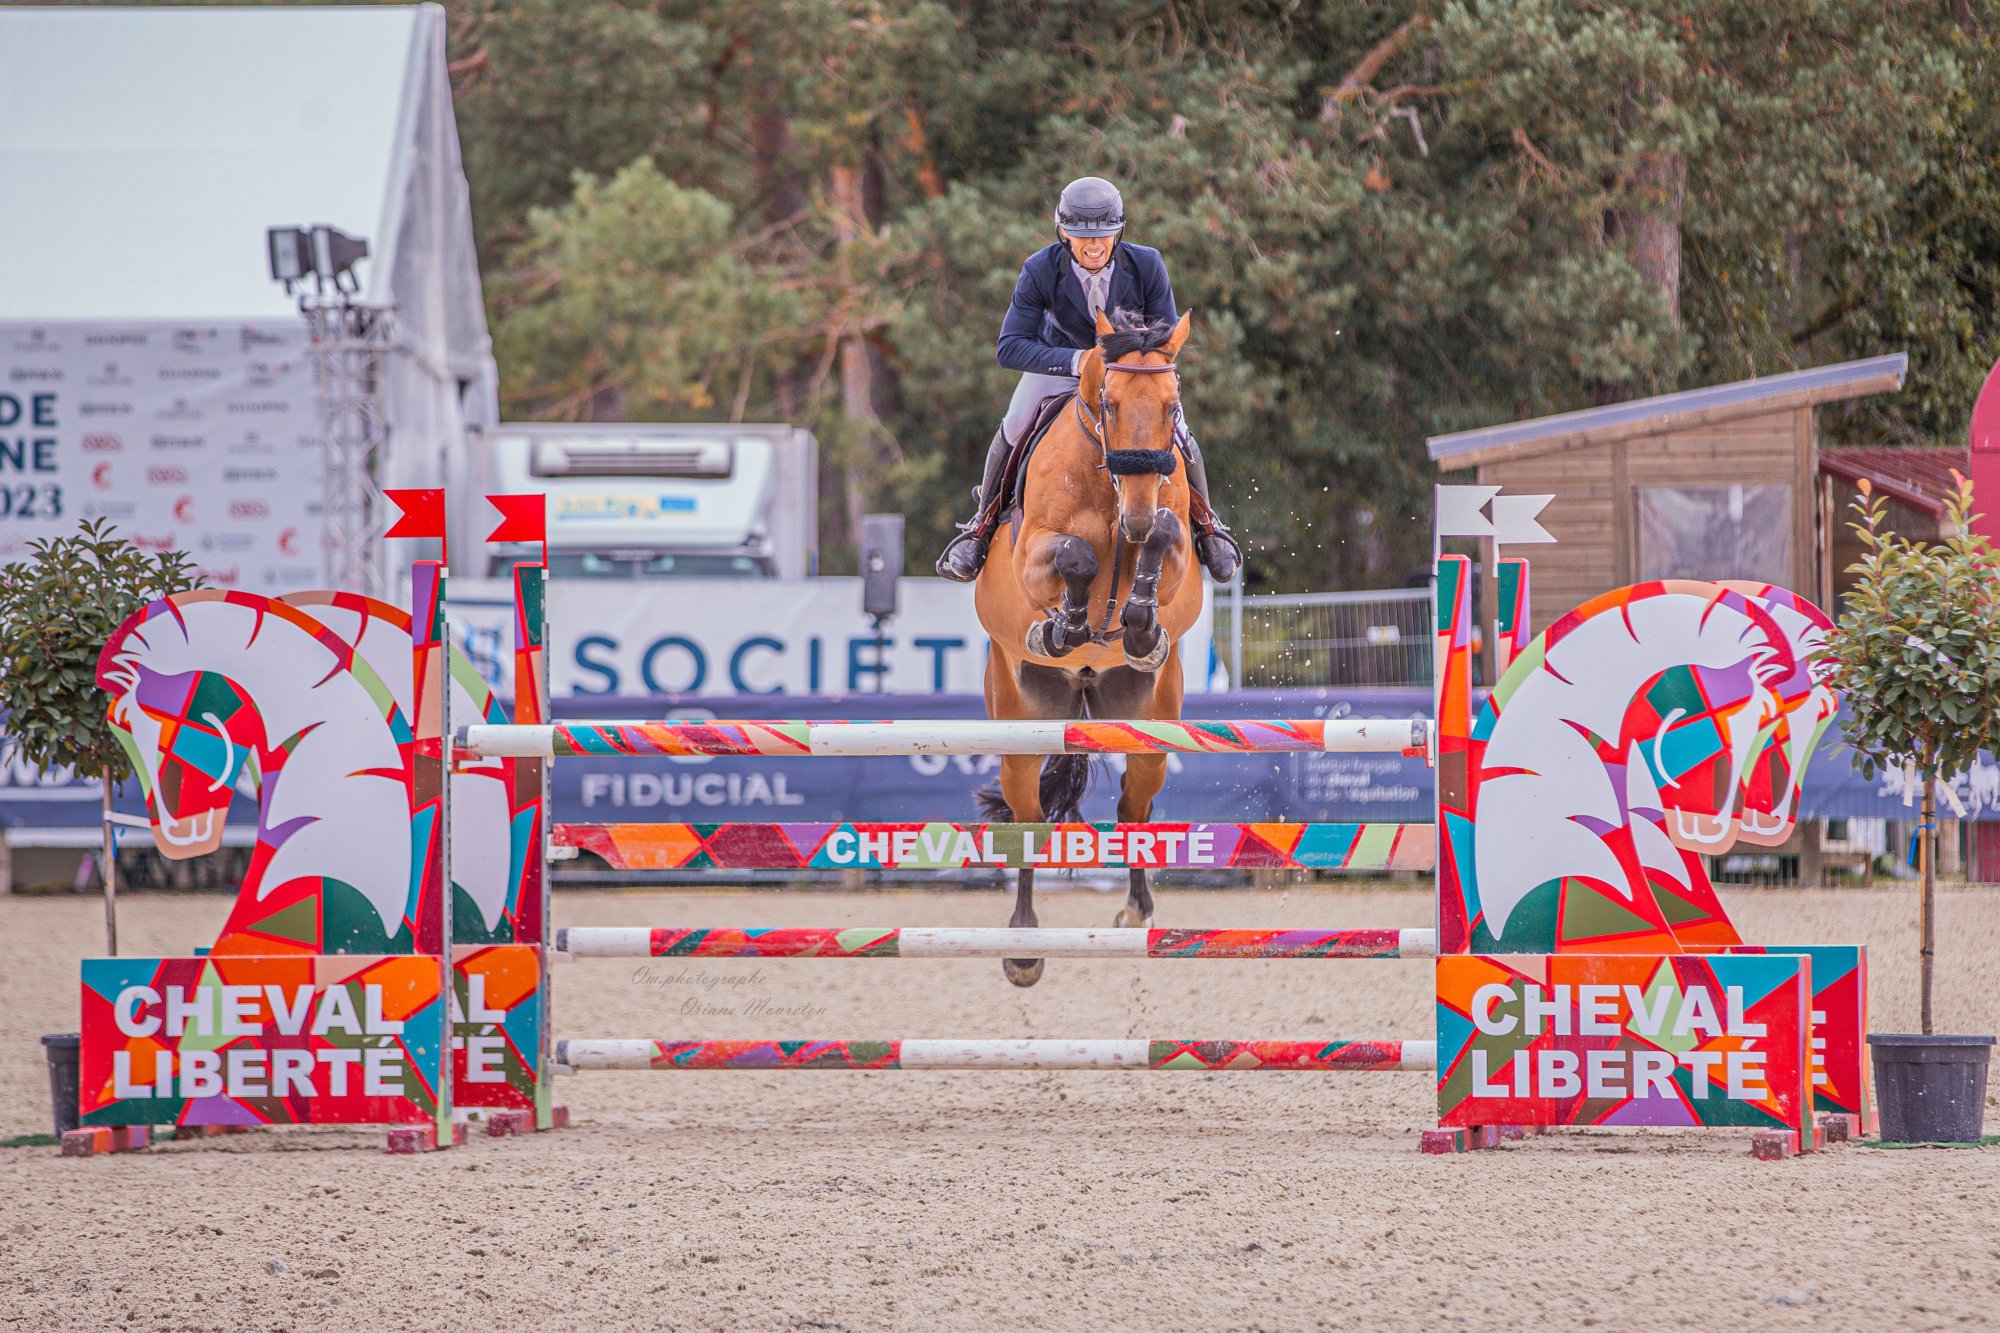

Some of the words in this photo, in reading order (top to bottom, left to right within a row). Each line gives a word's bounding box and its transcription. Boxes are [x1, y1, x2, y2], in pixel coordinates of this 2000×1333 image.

[582, 773, 805, 807] FIDUCIAL
[826, 831, 1007, 864] CHEVAL
[1023, 823, 1215, 864] LIBERTÉ
[113, 984, 405, 1038] CHEVAL
[1471, 984, 1767, 1037] CHEVAL
[112, 1034, 406, 1099] LIBERTÉ
[1471, 1039, 1768, 1099] LIBERTÉ
